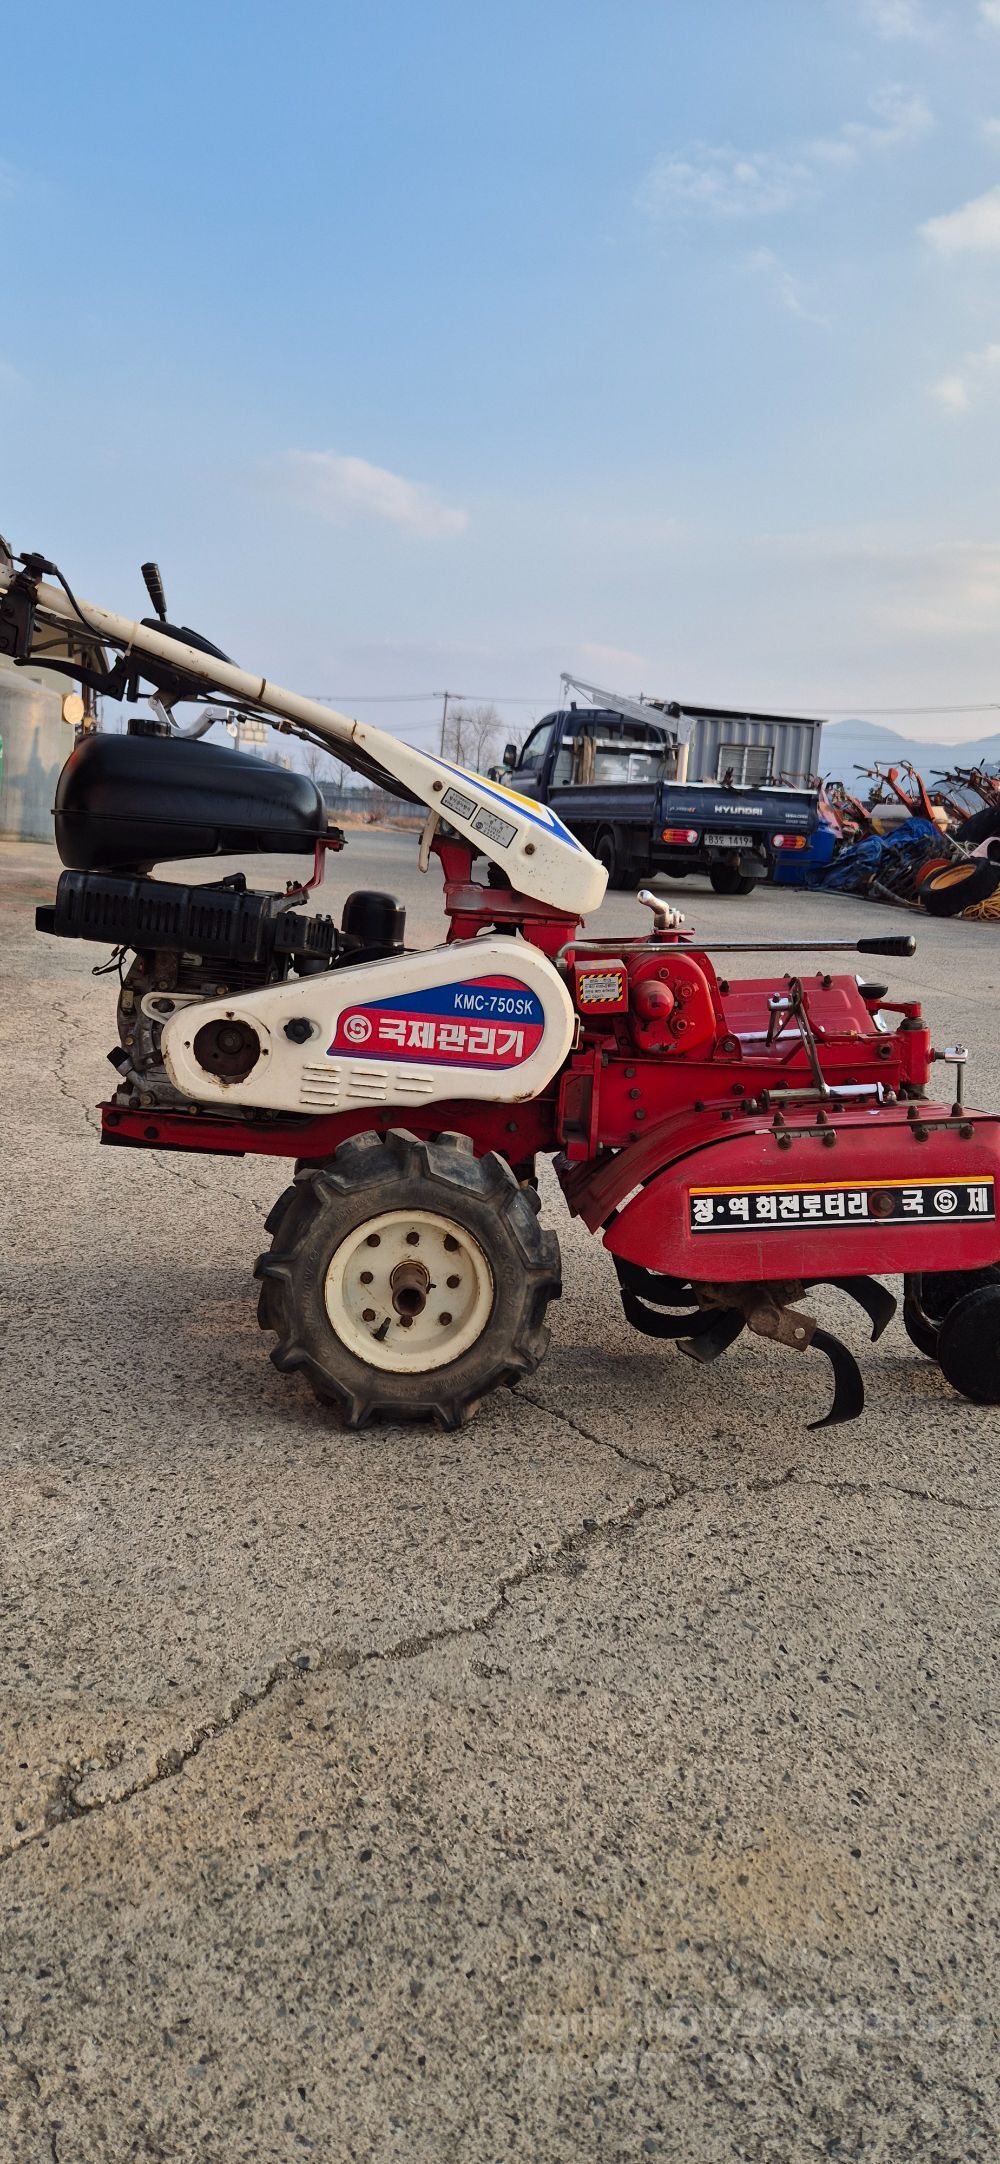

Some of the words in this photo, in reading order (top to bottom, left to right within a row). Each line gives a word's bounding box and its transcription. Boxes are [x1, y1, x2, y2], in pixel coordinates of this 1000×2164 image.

[714, 805, 763, 816] HYUNDAI
[454, 993, 533, 1015] KMC-750SK
[378, 1018, 525, 1058] 국제관리기
[755, 1192, 869, 1220] 회전로터리
[901, 1189, 925, 1214] 국
[967, 1187, 988, 1213] 제
